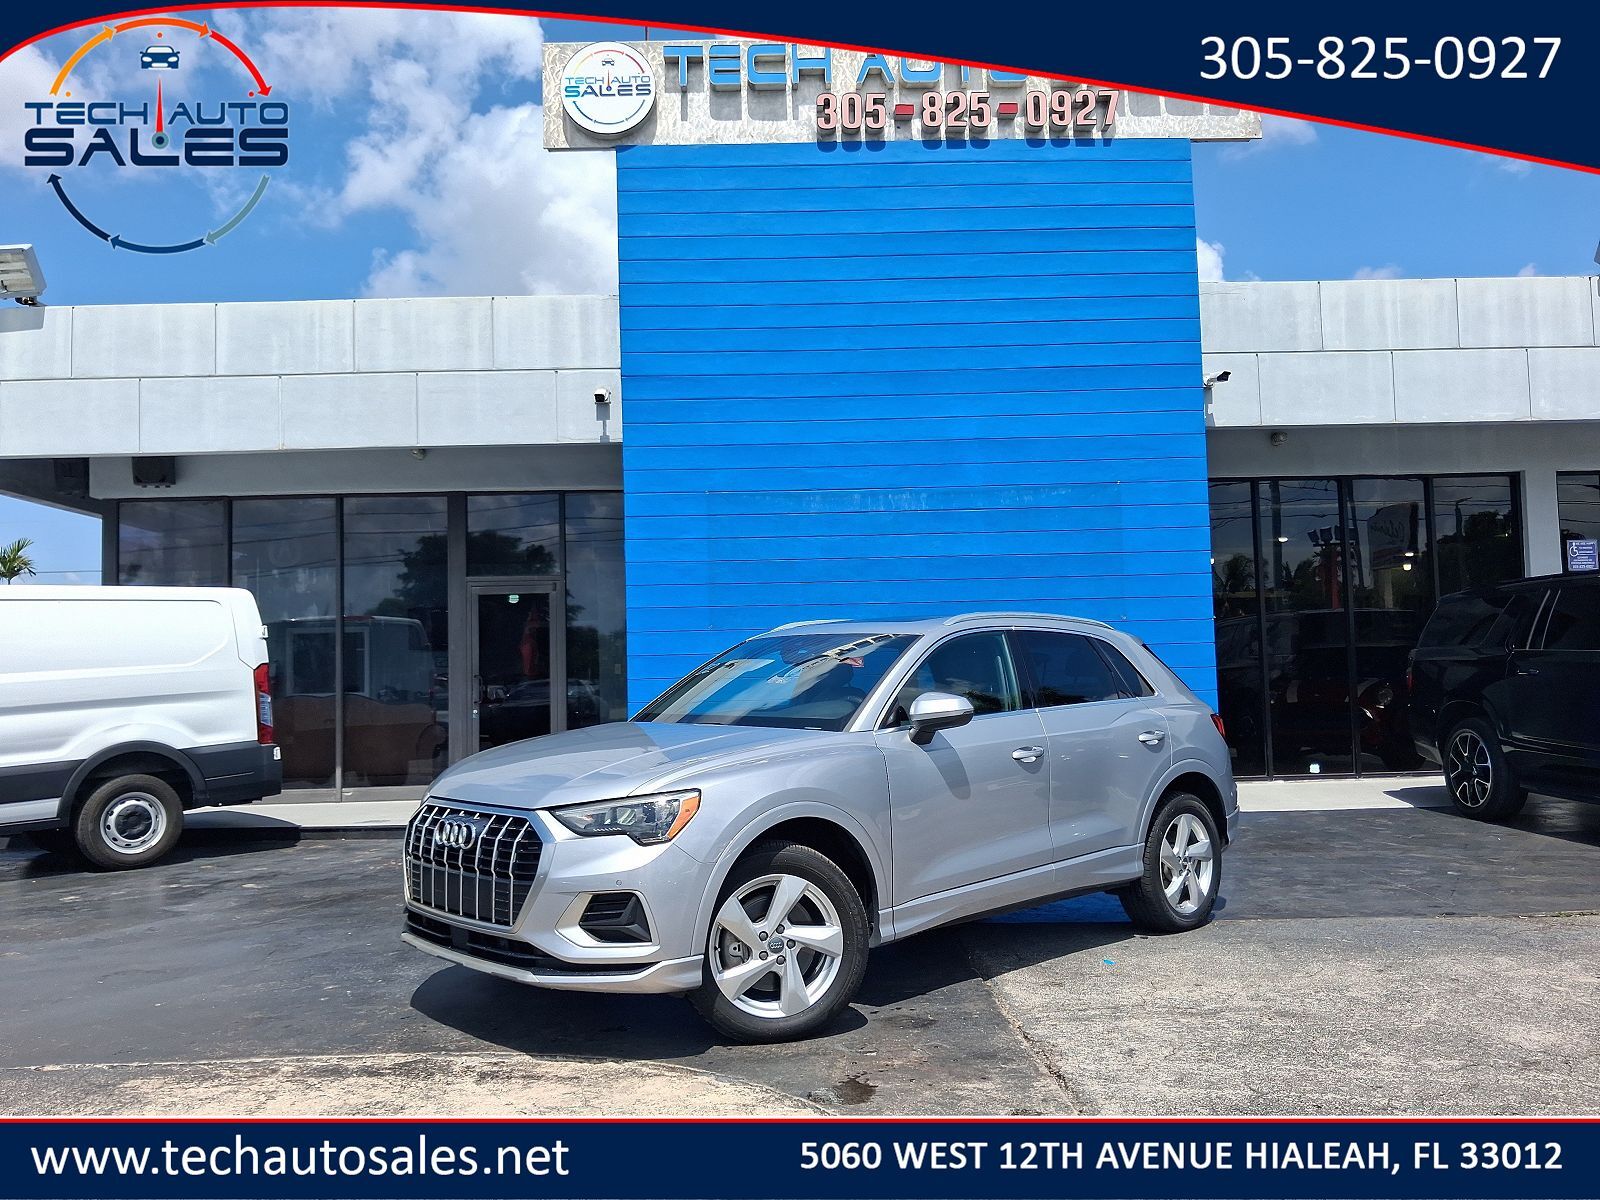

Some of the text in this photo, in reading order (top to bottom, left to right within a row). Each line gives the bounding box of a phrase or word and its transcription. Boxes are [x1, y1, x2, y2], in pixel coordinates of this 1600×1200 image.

[662, 43, 832, 88] TECH
[564, 75, 651, 85] TECH AUTO
[564, 84, 652, 98] SALES
[816, 89, 1120, 131] 305-825-0927
